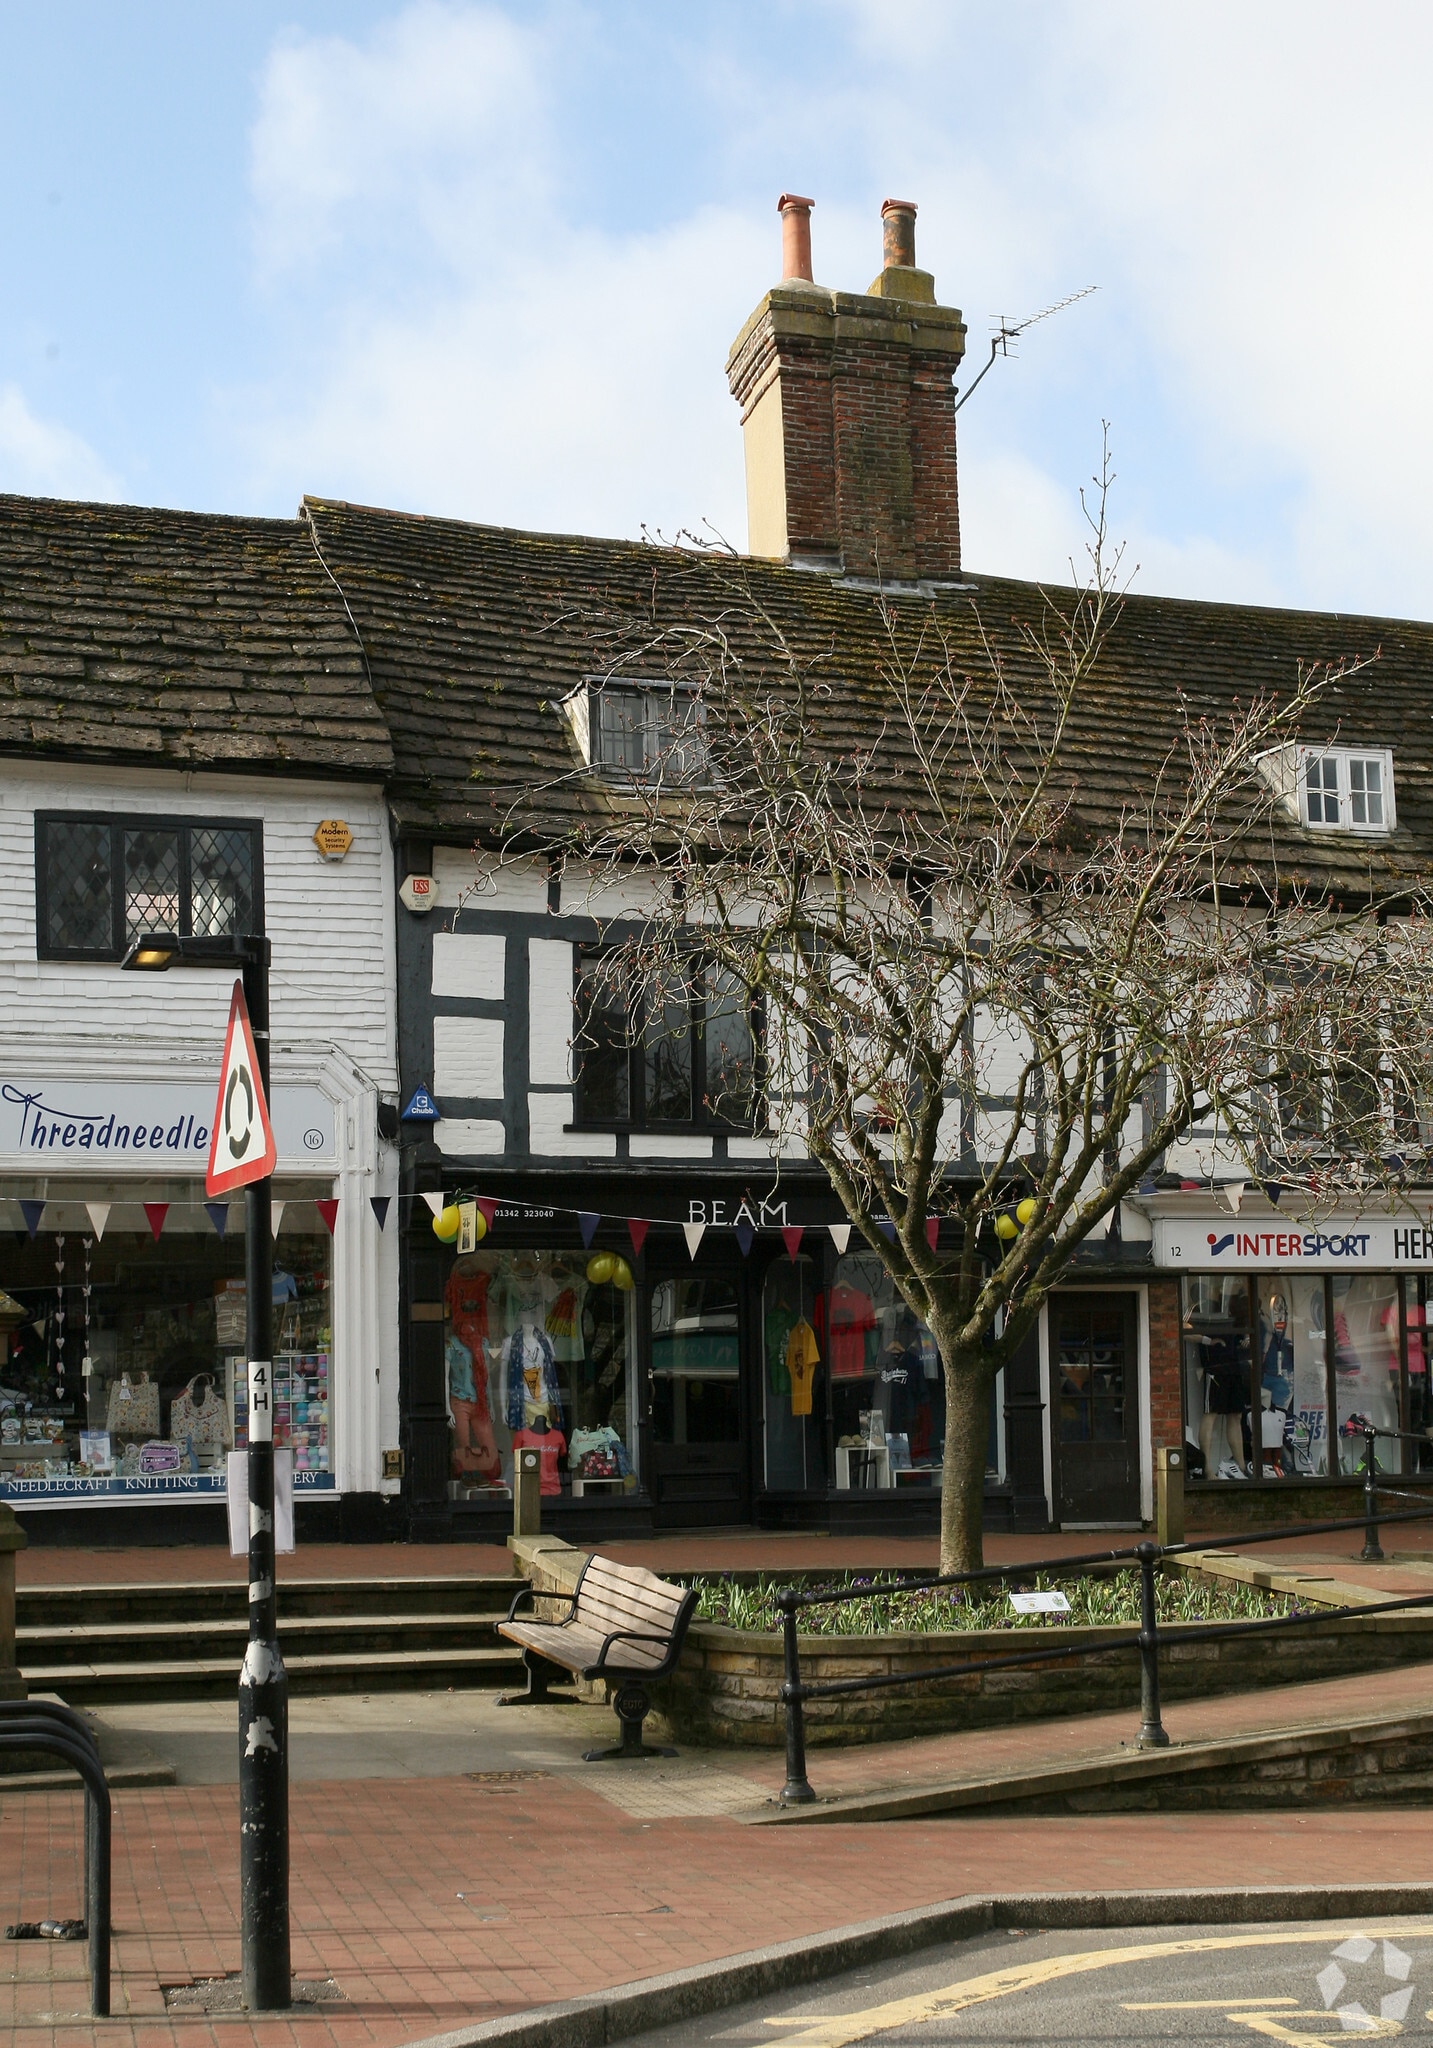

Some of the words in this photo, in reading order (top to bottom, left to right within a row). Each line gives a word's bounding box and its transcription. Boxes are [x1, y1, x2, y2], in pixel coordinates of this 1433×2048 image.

[321, 827, 349, 835] Modern
[414, 881, 428, 891] ESS
[2, 1085, 214, 1149] Threadneedle
[494, 1209, 519, 1217] 01342
[1171, 1246, 1181, 1256] 12
[1237, 1234, 1370, 1256] INTERSPORT
[1394, 1228, 1433, 1259] HER
[253, 1367, 267, 1385] 4
[253, 1392, 268, 1410] H
[7, 1479, 111, 1493] NEEDLECRAFT
[125, 1475, 198, 1489] KNITTING
